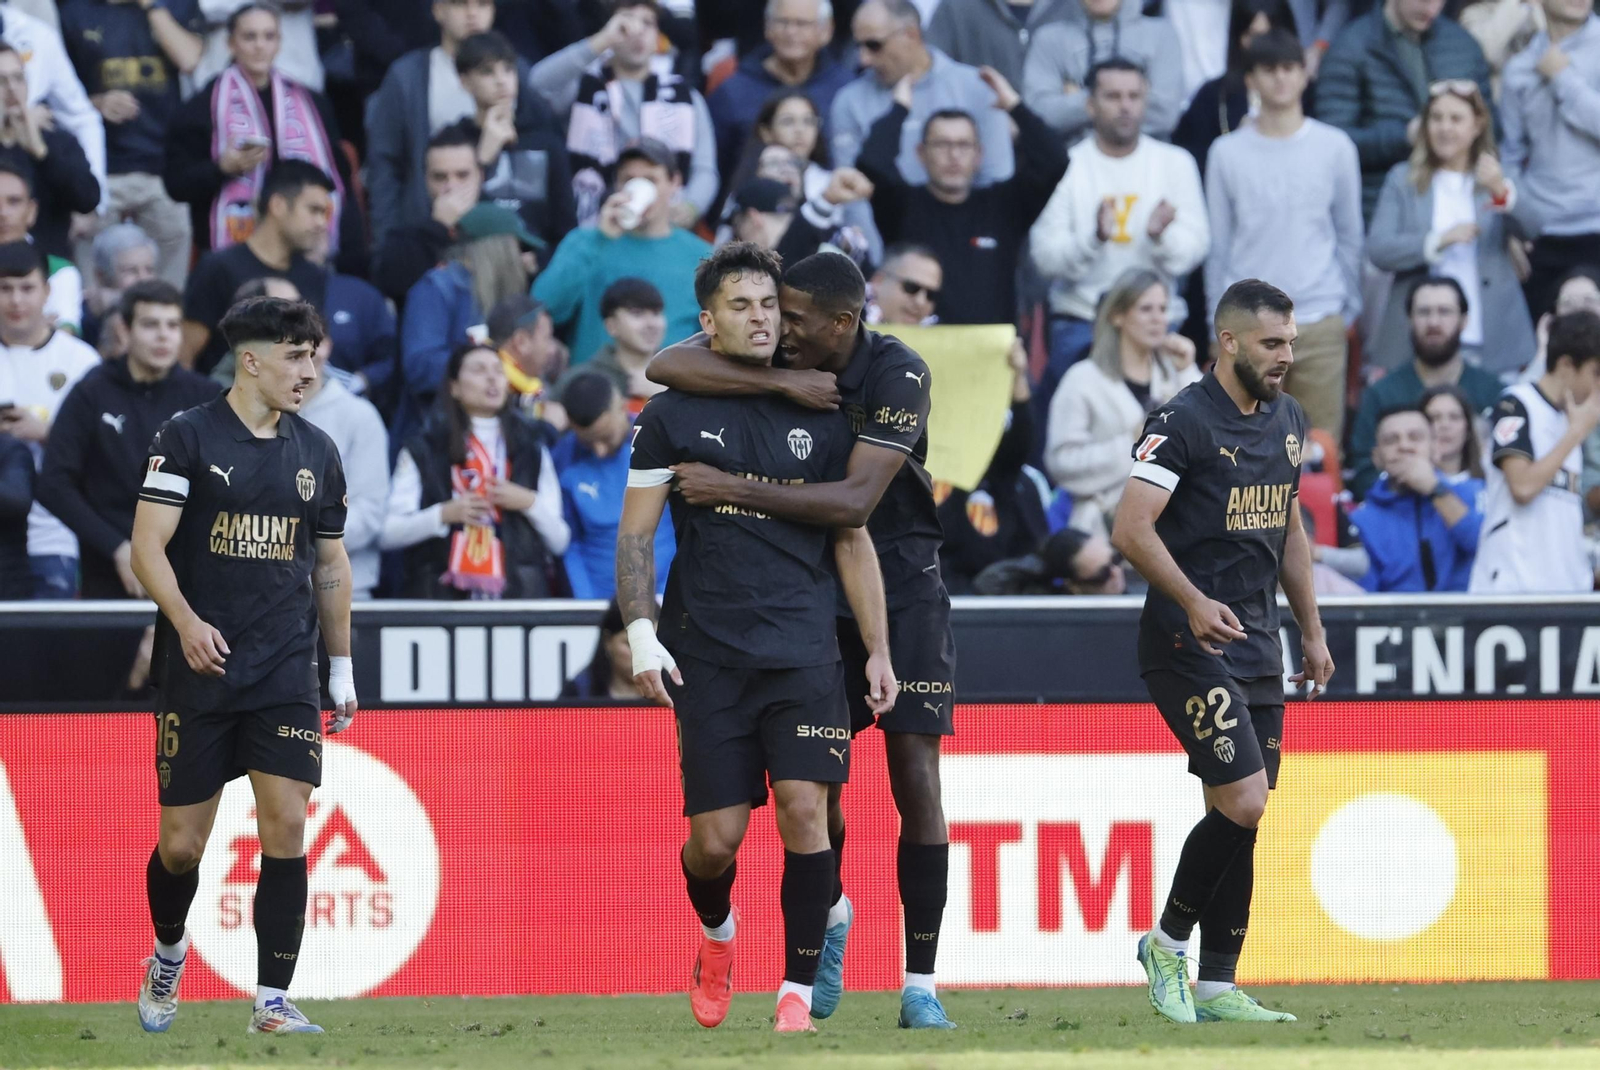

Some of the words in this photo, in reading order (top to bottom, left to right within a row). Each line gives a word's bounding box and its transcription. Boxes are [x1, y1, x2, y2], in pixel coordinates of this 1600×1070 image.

[874, 406, 918, 426] divina
[1227, 483, 1292, 514] AMUNT
[210, 511, 300, 544] AMUNT
[1226, 511, 1287, 531] VALENCIANS
[209, 536, 295, 561] VALENCIANS
[1185, 686, 1238, 740] 22
[156, 711, 180, 758] 16
[948, 820, 1154, 933] TM
[219, 890, 394, 930] SRTS
[913, 932, 936, 941] VCF
[274, 951, 297, 961] VCF
[797, 947, 820, 956] VCF
